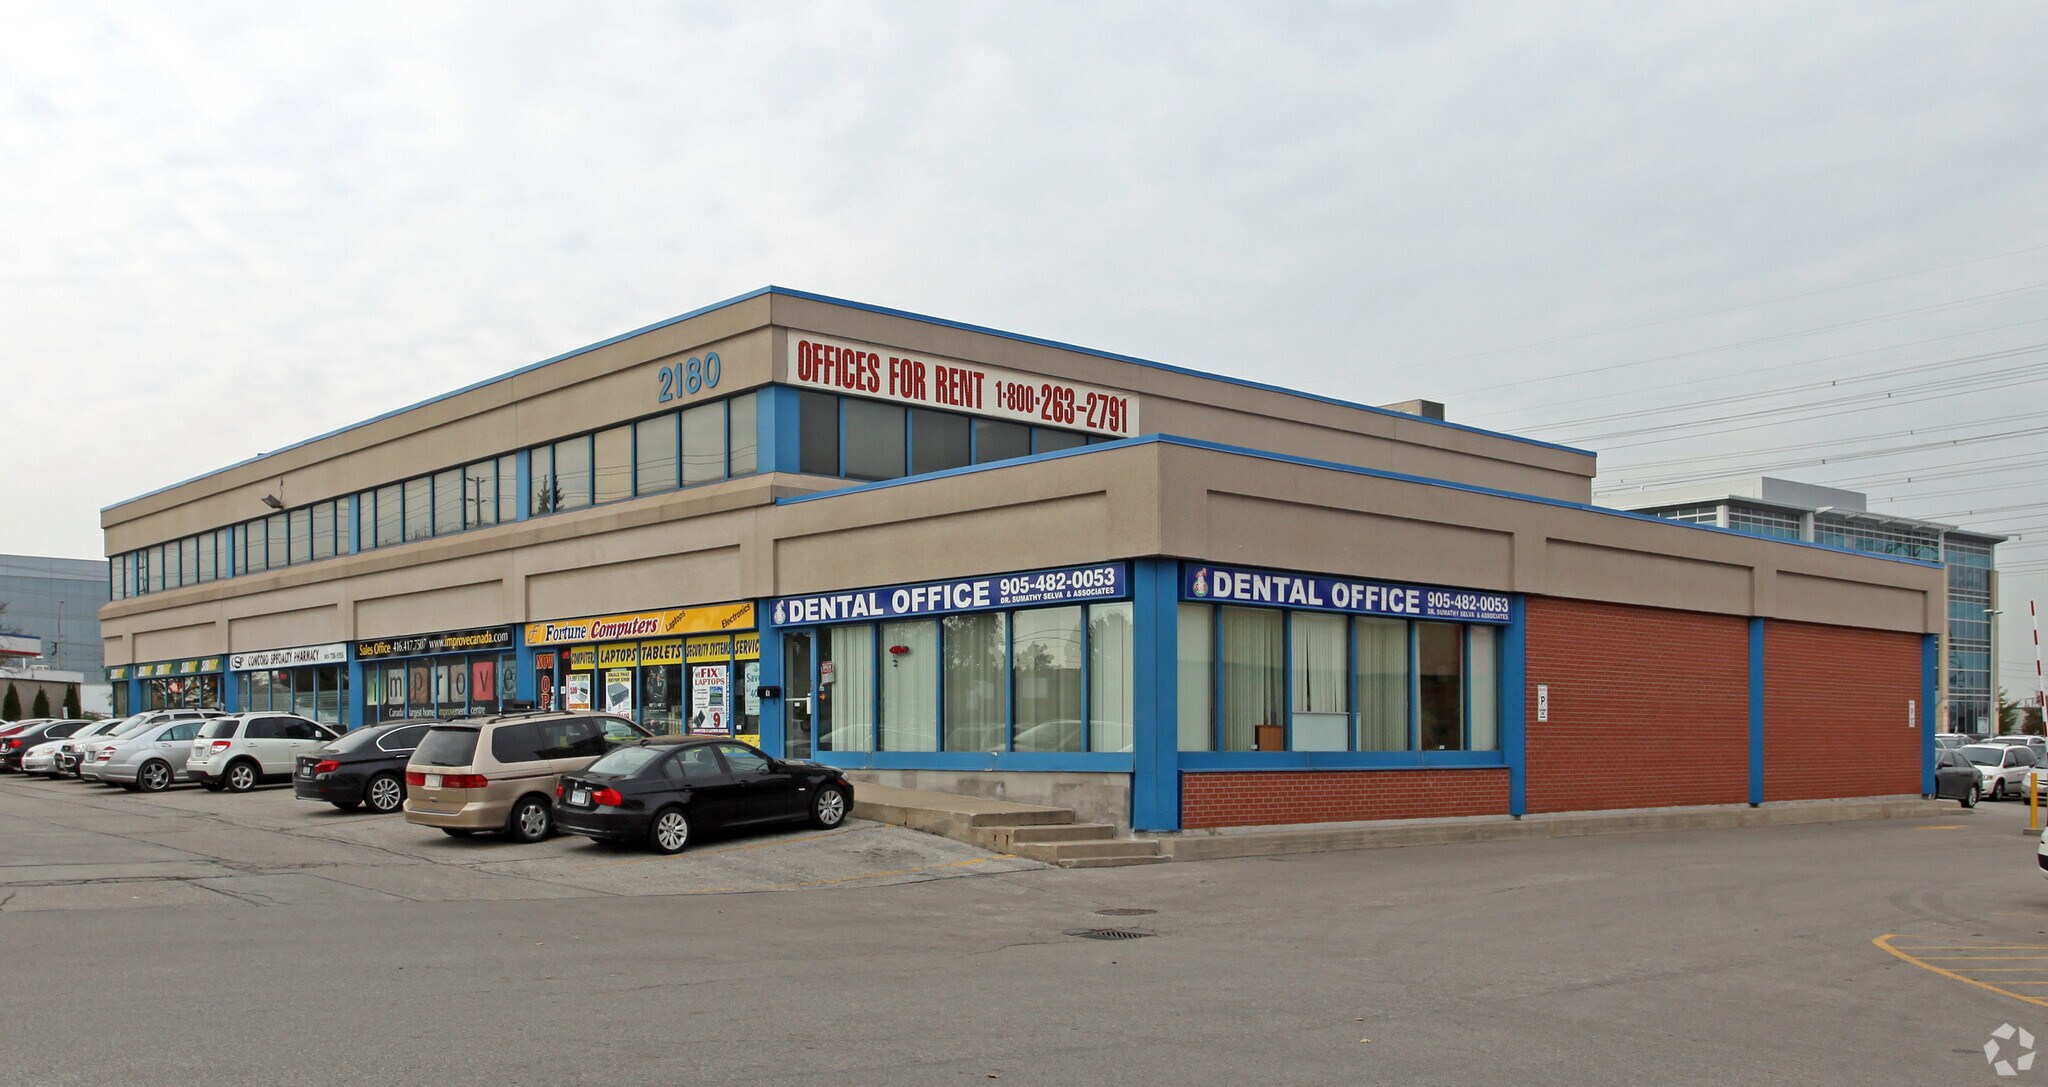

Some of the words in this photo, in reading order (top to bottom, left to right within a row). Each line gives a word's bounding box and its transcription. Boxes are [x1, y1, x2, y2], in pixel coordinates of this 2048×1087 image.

[658, 351, 721, 402] 2180
[797, 340, 880, 393] OFFICES
[889, 356, 926, 401] FOR
[935, 364, 985, 409] RENT
[1000, 567, 1115, 596] 905-482-0053
[1000, 596, 1011, 604] DR.
[1012, 593, 1042, 603] SUMATHY
[1043, 591, 1063, 600] SELVA
[1066, 590, 1072, 598] &
[1073, 586, 1115, 597] ASSOCIATES
[1213, 570, 1323, 606] DENTAL
[1331, 582, 1421, 614] OFFICE
[789, 592, 884, 622] DENTAL
[891, 581, 991, 612] OFFICE
[721, 603, 751, 628] Electronics
[1481, 612, 1509, 620] ASSOCIATES
[545, 624, 586, 642] Fortune
[590, 617, 658, 639] Computers
[665, 610, 686, 632] Laptops
[359, 643, 373, 656] Sales
[373, 642, 391, 655] Office
[393, 638, 427, 652] 416.417.7507
[428, 630, 508, 649] www.improvecanada.com
[735, 638, 759, 655] SERVIC
[247, 655, 269, 667] CONCORD
[270, 651, 292, 664] SPECIALTY
[294, 649, 320, 663] PHARMACY
[600, 647, 637, 664] LAPTOPS
[641, 644, 682, 660] TABLETS
[686, 642, 709, 658] SECURITY
[536, 653, 554, 669] NOW
[695, 677, 725, 686] LAPTOPS
[700, 667, 718, 678] FIX
[746, 673, 759, 682] Sav
[470, 701, 486, 715] centre
